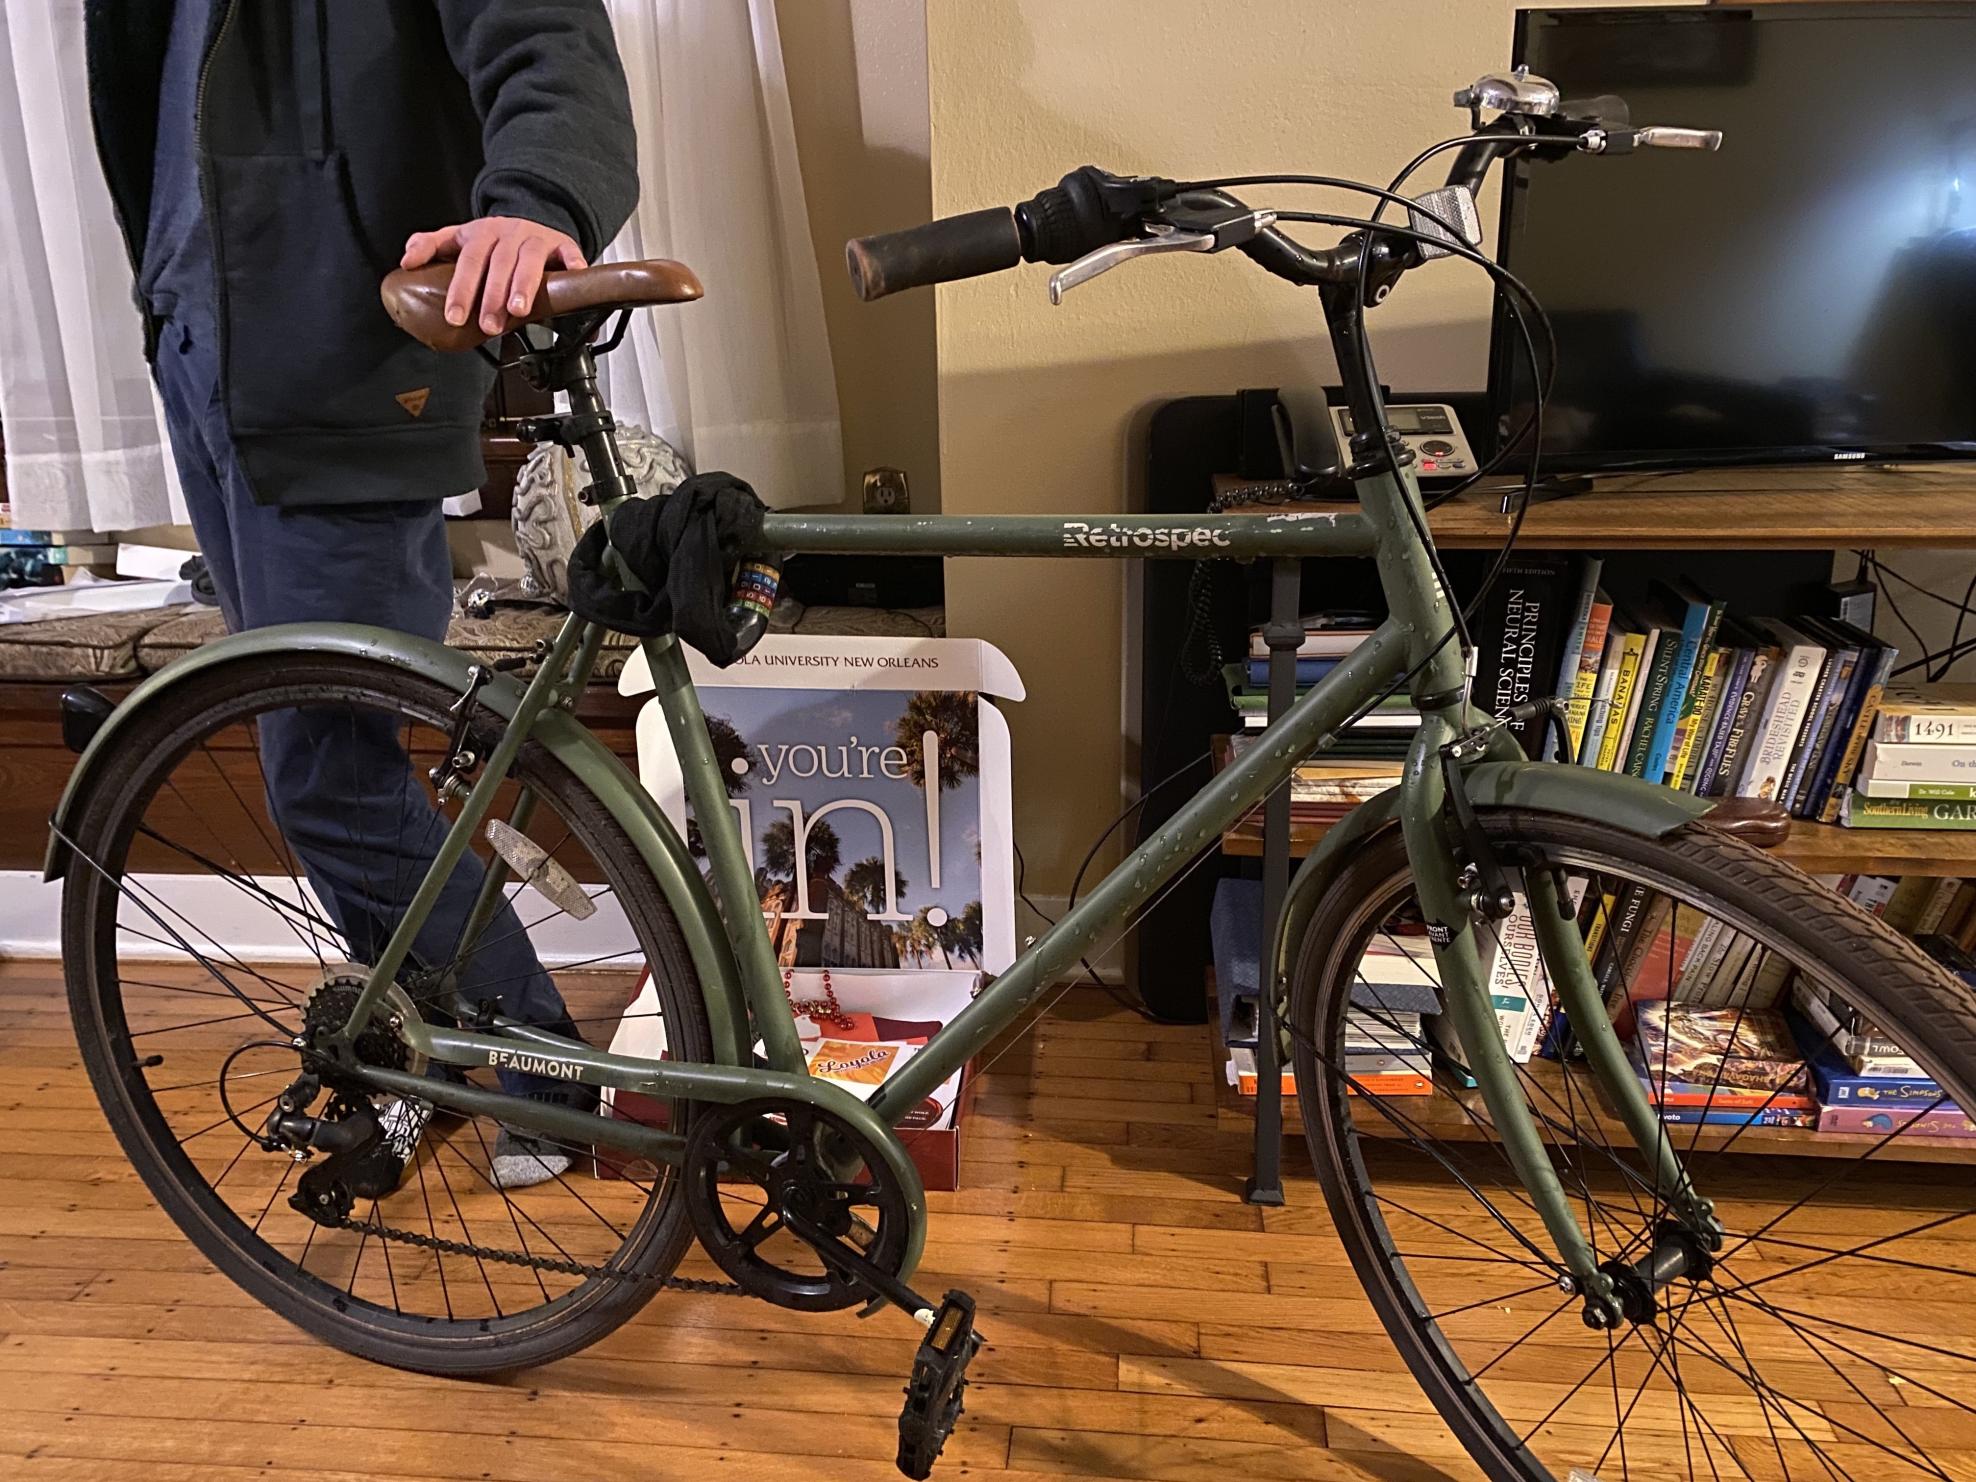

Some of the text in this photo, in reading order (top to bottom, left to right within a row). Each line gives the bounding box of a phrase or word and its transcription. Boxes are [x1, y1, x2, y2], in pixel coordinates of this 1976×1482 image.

[1063, 522, 1231, 551] Retrospec
[1500, 589, 1525, 663] NEURAL
[765, 655, 839, 667] UNIVERSITY
[844, 656, 874, 667] NEW
[877, 657, 939, 668] ORLEANS
[1513, 602, 1540, 703] PRINCIPLES
[1658, 638, 1678, 681] SILENT
[1648, 674, 1668, 711] SPRING
[1665, 640, 1697, 724] Central America
[1638, 717, 1655, 753] RACHEL
[1718, 691, 1756, 776] GRAVE FIREFLIES
[1761, 691, 1792, 765] BRIDESHEAD
[1773, 699, 1800, 760] REVISITED
[1915, 721, 1953, 739] 1491
[757, 736, 908, 785] you're
[1952, 760, 1965, 768] On
[1863, 802, 1976, 820] Southern Living GAR
[1620, 899, 1641, 933] FUNGI
[1495, 914, 1518, 985] OURSELVES
[1640, 928, 1651, 944] The
[1693, 942, 1708, 964] BACK
[1704, 956, 1720, 979] Slow
[1684, 963, 1698, 982] PAIN
[488, 1050, 584, 1081] BEAUMONT
[818, 1049, 889, 1073] Loyola
[1723, 1070, 1769, 1083] BHAGAVA
[1900, 1085, 1943, 1098] SIMPSONS
